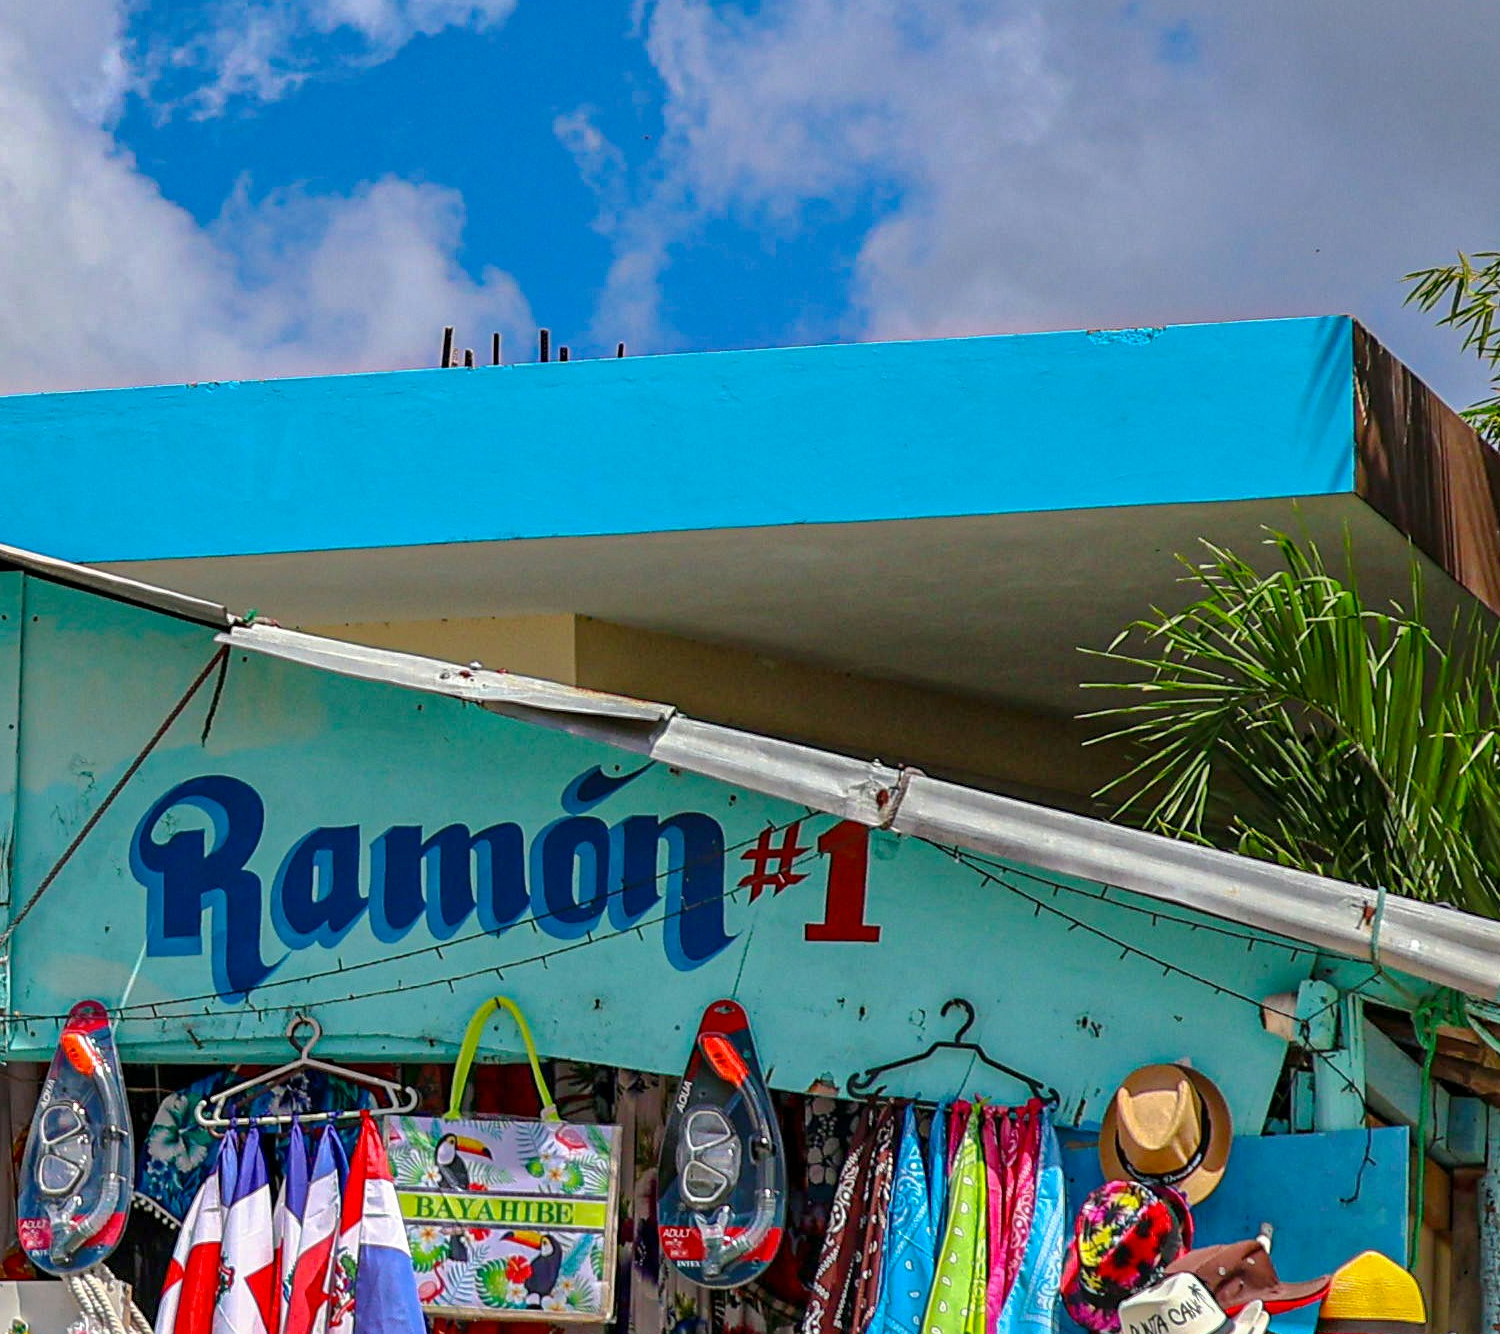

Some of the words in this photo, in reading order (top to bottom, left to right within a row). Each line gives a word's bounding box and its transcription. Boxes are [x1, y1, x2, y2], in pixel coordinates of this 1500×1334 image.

[128, 761, 738, 1004] Ramón
[738, 817, 882, 944] #1
[676, 1080, 694, 1113] AQUA
[413, 1195, 576, 1225] BAYAHIBE
[662, 1227, 691, 1238] ADULT
[676, 1259, 701, 1268] INTEX
